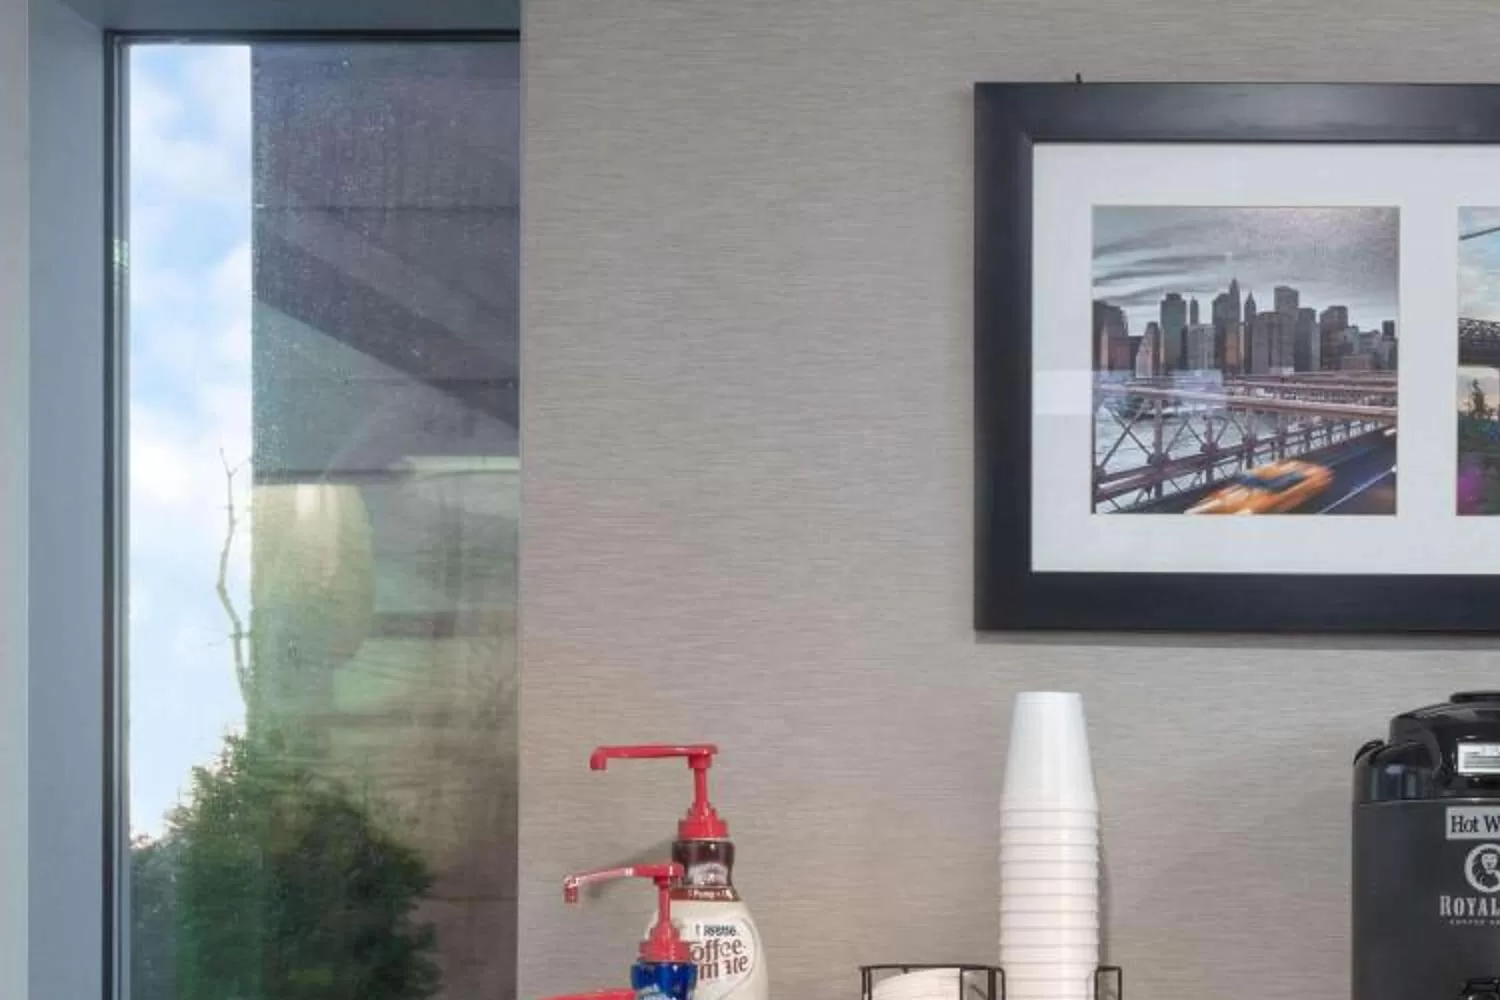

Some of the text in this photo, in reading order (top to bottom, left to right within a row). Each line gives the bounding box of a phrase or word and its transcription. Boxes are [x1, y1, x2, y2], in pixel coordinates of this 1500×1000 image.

[1451, 815, 1479, 833] Hot
[1440, 896, 1500, 916] ROYAL
[691, 938, 743, 963] offee
